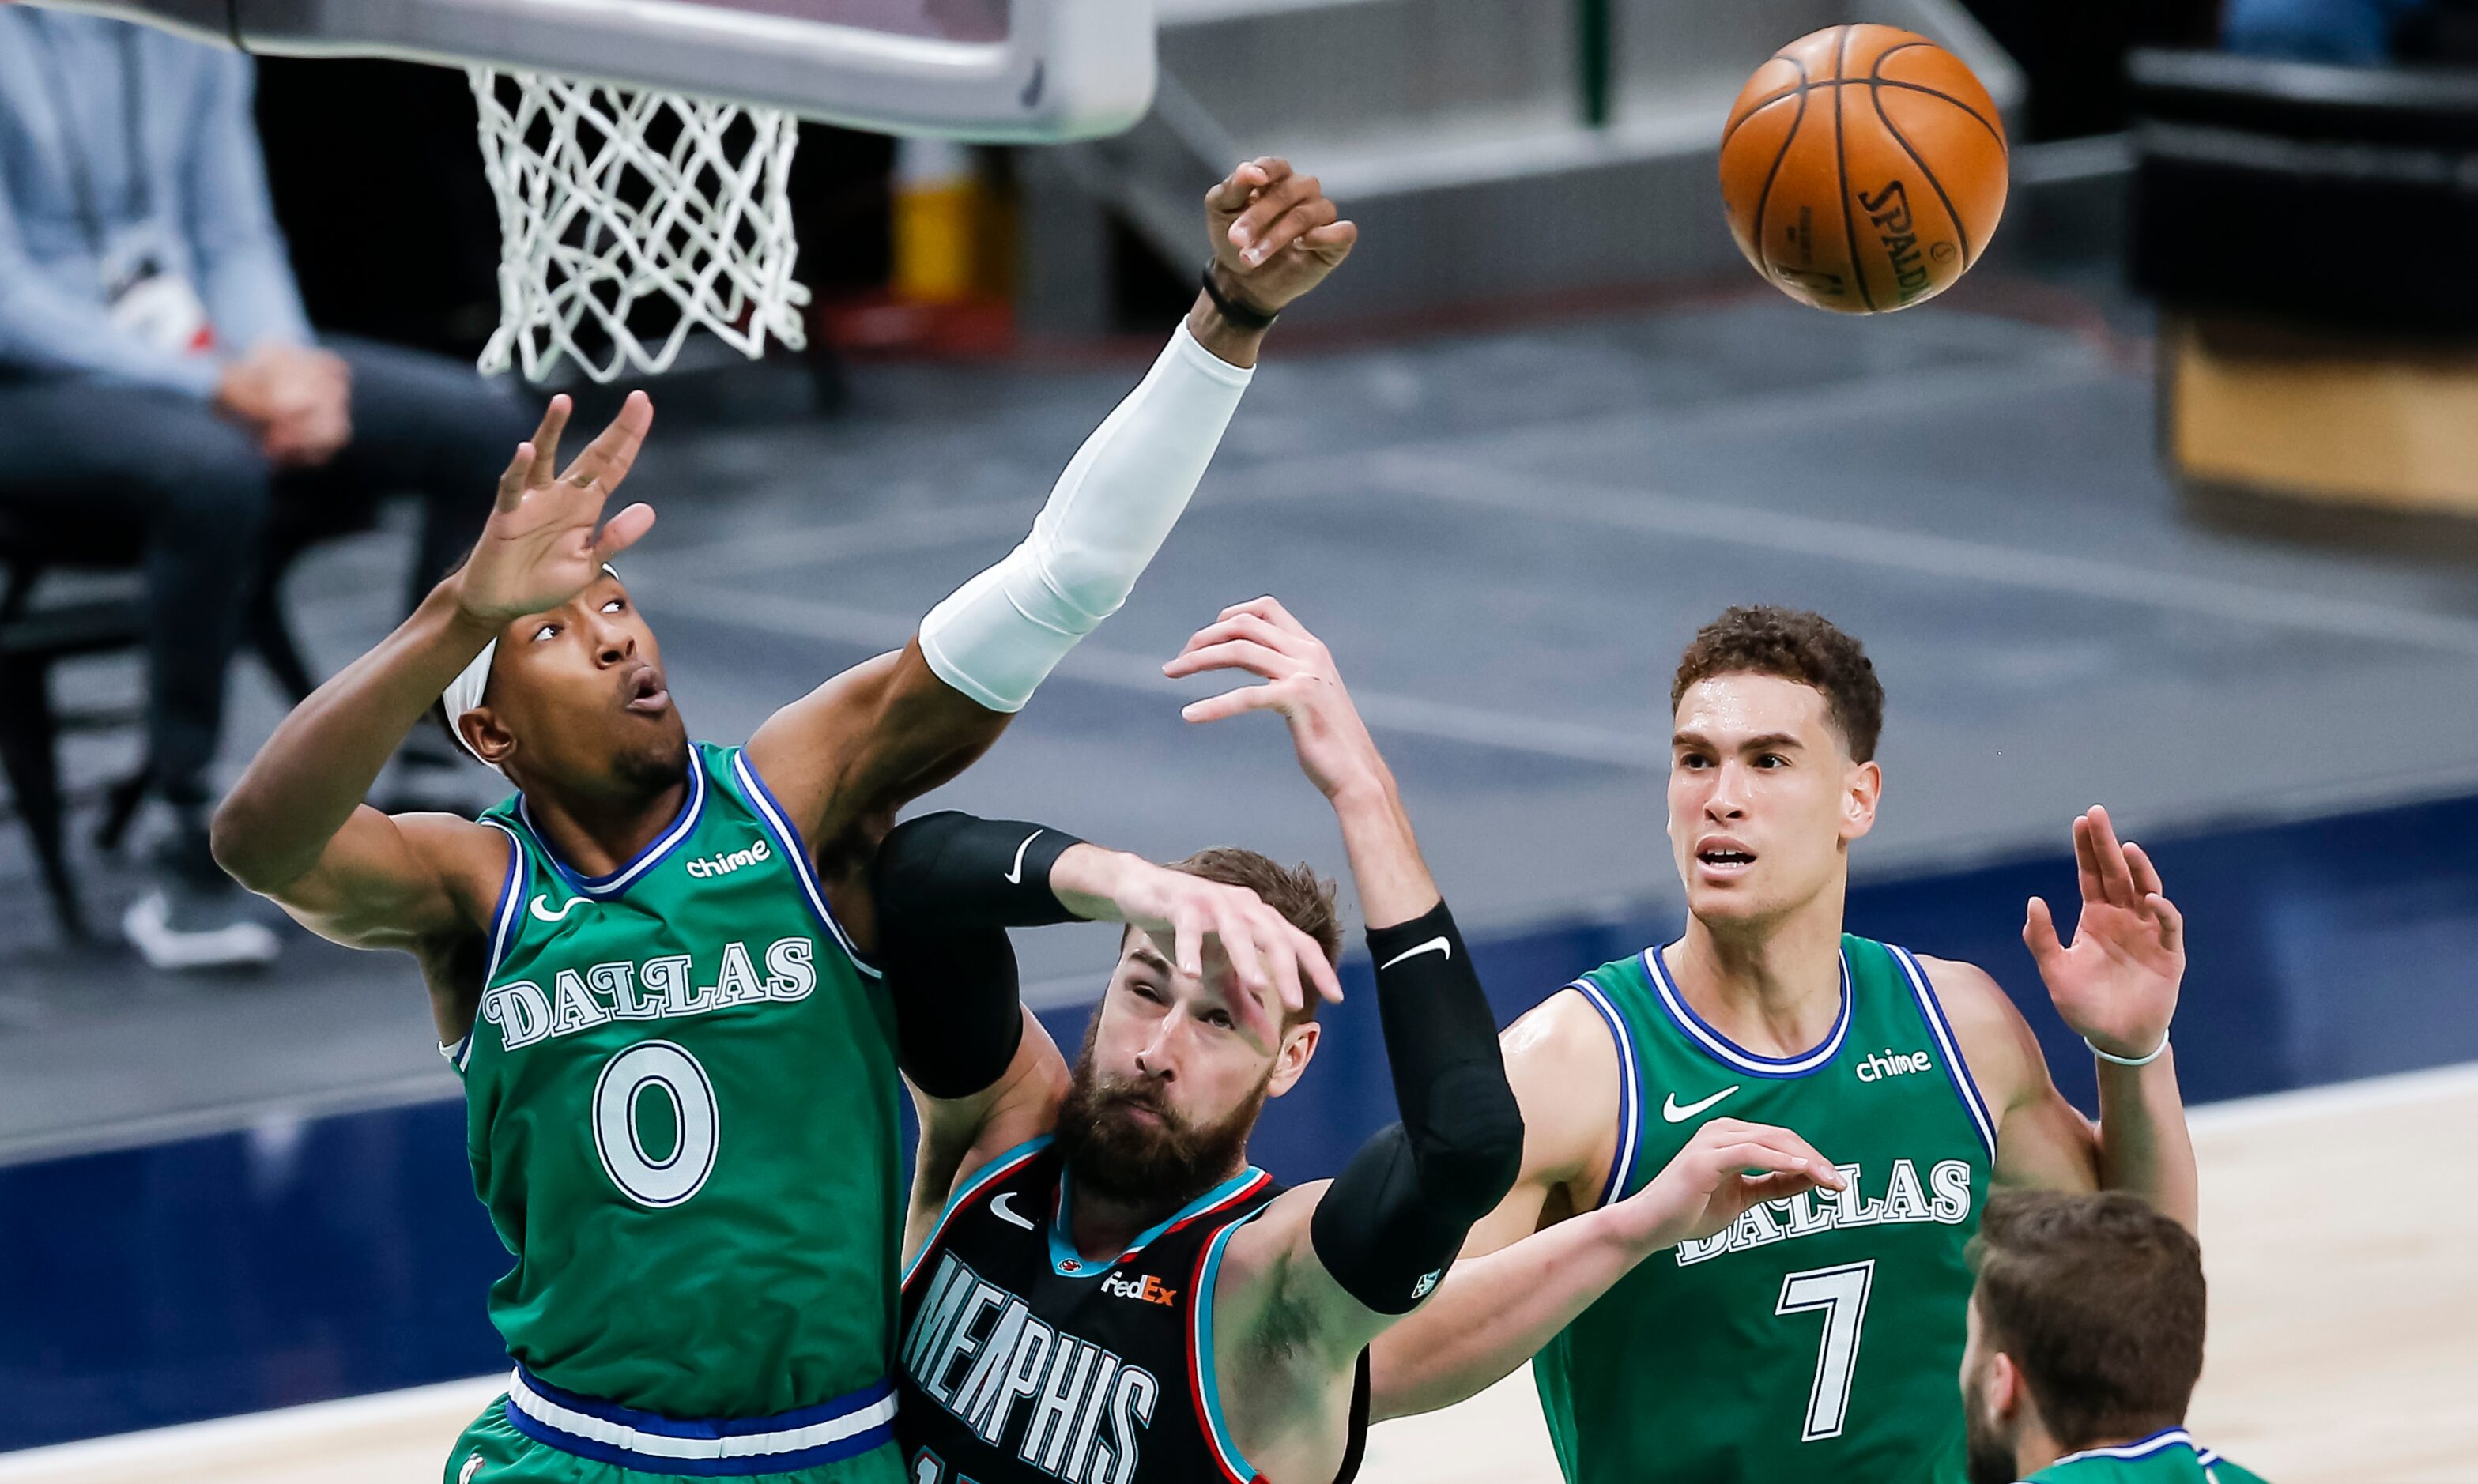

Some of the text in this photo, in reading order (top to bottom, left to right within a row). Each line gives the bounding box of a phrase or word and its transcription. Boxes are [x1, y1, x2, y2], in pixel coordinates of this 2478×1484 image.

[686, 839, 771, 879] chime
[483, 937, 817, 1051] DALLAS
[592, 1039, 719, 1207] 0
[1856, 1049, 1933, 1083] chime
[1101, 1271, 1177, 1307] FedEx
[901, 1248, 1159, 1484] MEMPHIS
[1775, 1259, 1875, 1442] 7
